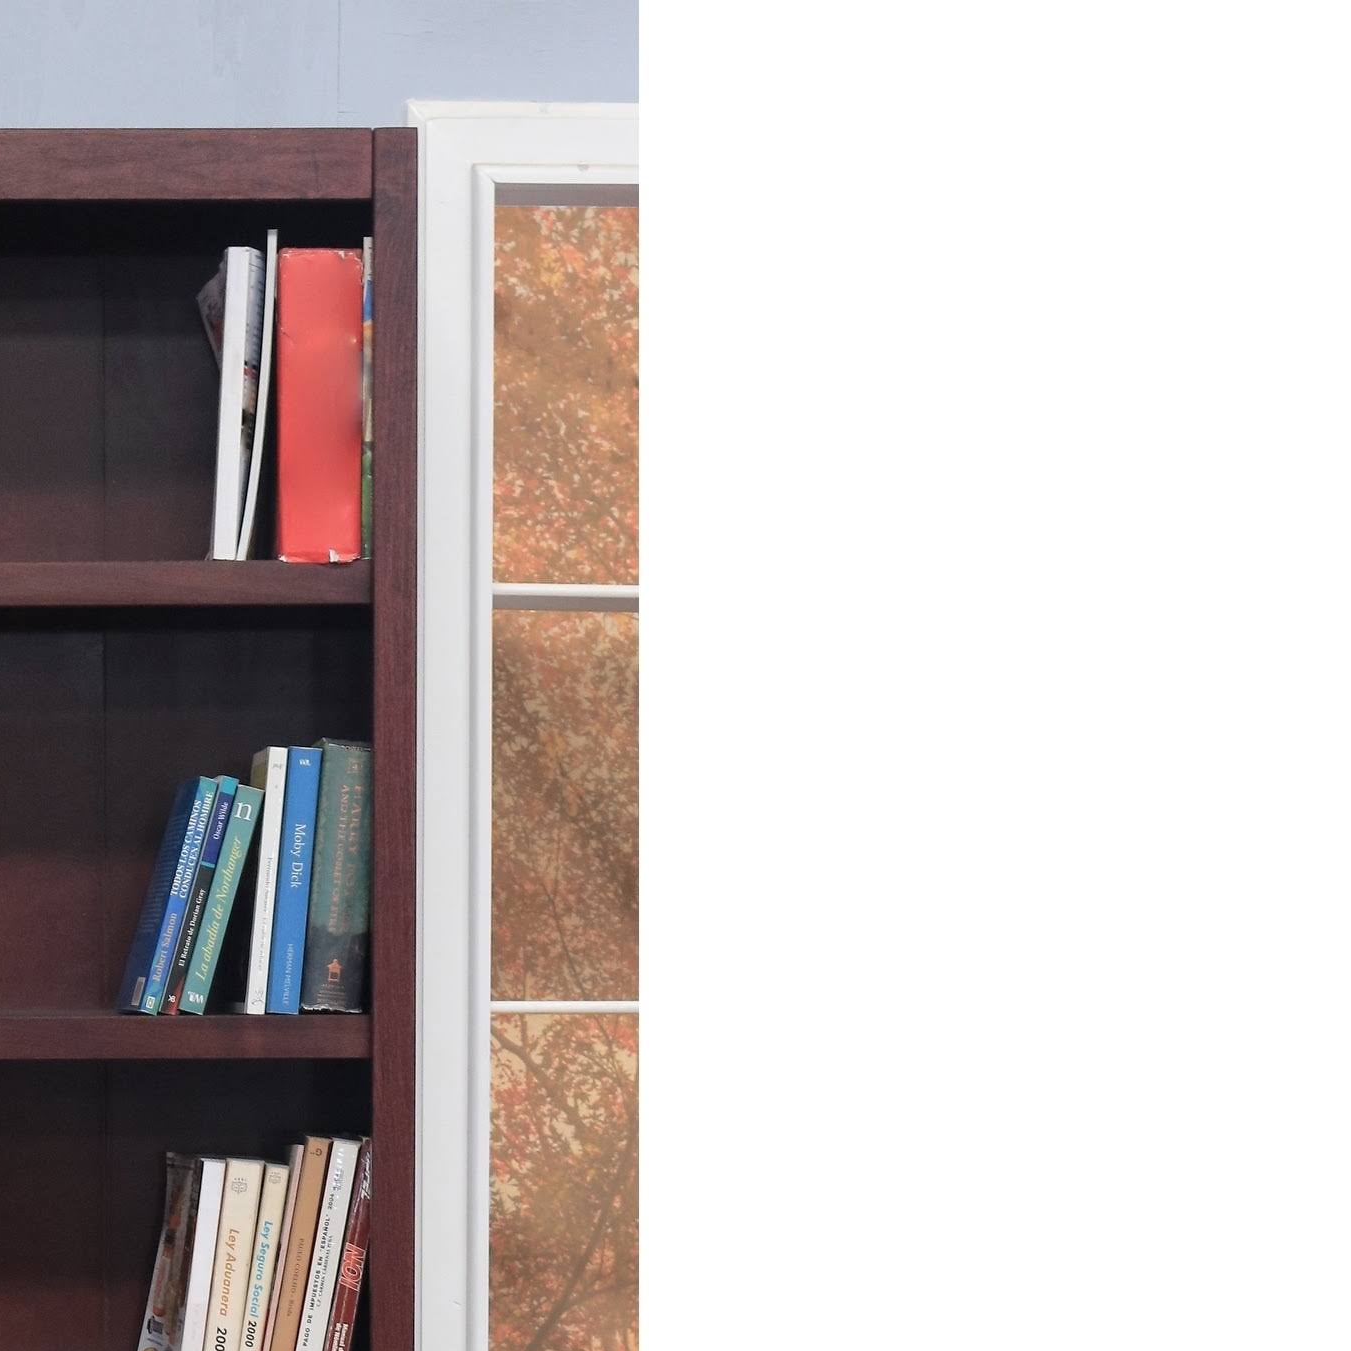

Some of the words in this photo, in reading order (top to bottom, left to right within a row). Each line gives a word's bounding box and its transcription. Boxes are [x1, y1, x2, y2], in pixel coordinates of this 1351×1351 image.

[197, 792, 215, 833] HOMBRE
[218, 801, 229, 821] Wilde
[194, 834, 203, 847] AL
[213, 824, 224, 840] Oscar
[291, 824, 307, 856] Moby
[170, 864, 184, 896] TODOS
[179, 844, 188, 864] LOS
[185, 800, 201, 844] CAMINOS
[179, 846, 199, 898] CONDUCEN
[215, 836, 243, 903] Northanger
[291, 862, 303, 888] Dick
[195, 888, 207, 904] Gray
[189, 906, 201, 928] Dorian
[211, 905, 224, 920] de
[187, 927, 194, 936] de
[152, 950, 167, 982] Robert
[163, 912, 177, 948] Salmon
[180, 936, 191, 959] Retrato
[285, 943, 293, 974] HERMAN
[178, 959, 185, 967] El
[195, 964, 208, 982] La
[226, 1228, 240, 1250] Ley
[261, 1220, 273, 1240] Ley
[256, 1244, 270, 1280] Seguro
[317, 1256, 323, 1266] EN
[339, 1242, 366, 1292] NOI
[219, 1253, 237, 1316] Aduanera
[309, 1270, 321, 1310] IMPUESTOS
[249, 1284, 263, 1318] Social
[307, 1314, 313, 1324] DE
[335, 1322, 341, 1331] de
[245, 1320, 257, 1348] 2000
[339, 1323, 349, 1347] Manual
